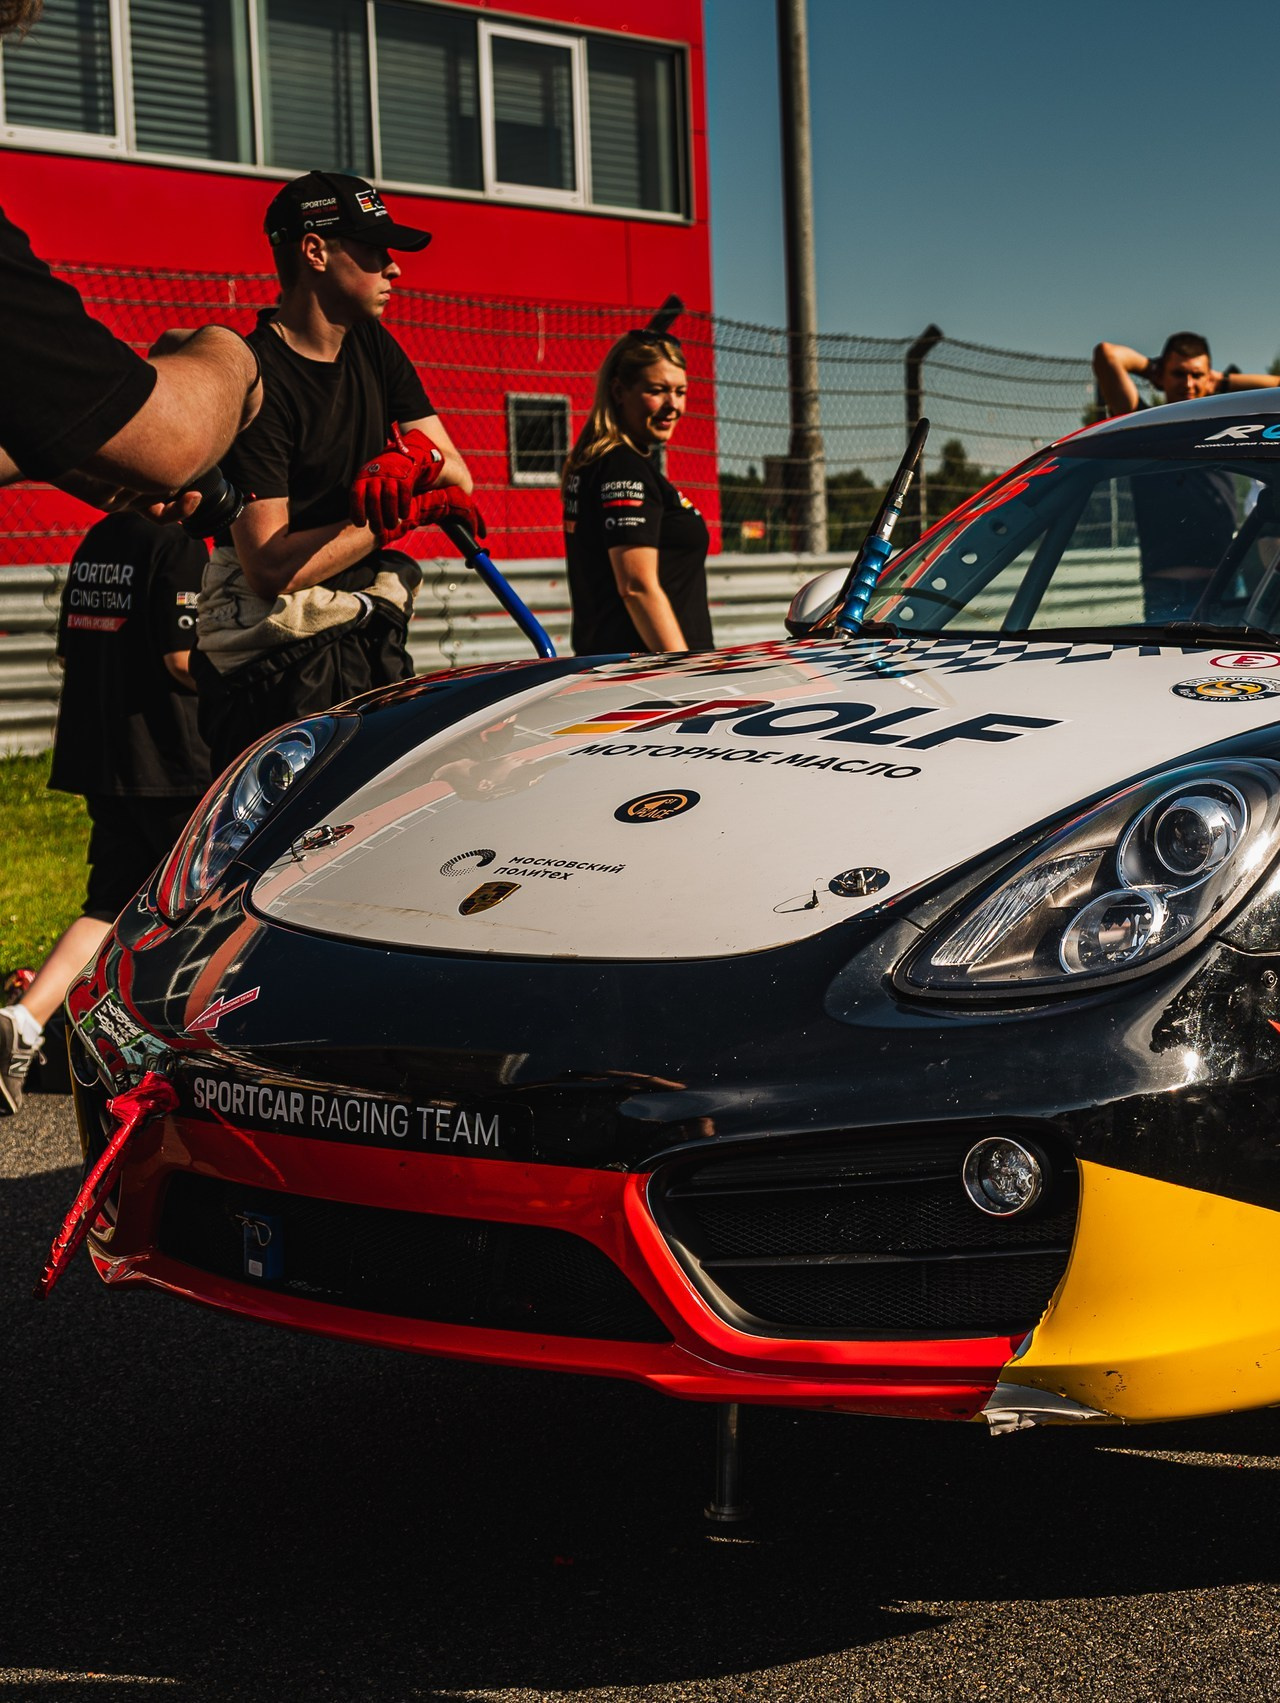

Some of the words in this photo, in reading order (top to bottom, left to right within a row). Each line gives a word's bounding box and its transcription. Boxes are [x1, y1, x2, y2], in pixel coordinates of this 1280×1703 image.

[623, 700, 1065, 751] ROLF
[570, 744, 783, 765] МОТОРНОЕ
[783, 753, 922, 779] МАСЛО
[193, 1077, 304, 1125] SPORTCAR
[311, 1096, 409, 1138] RACING
[416, 1107, 500, 1147] TEAM
